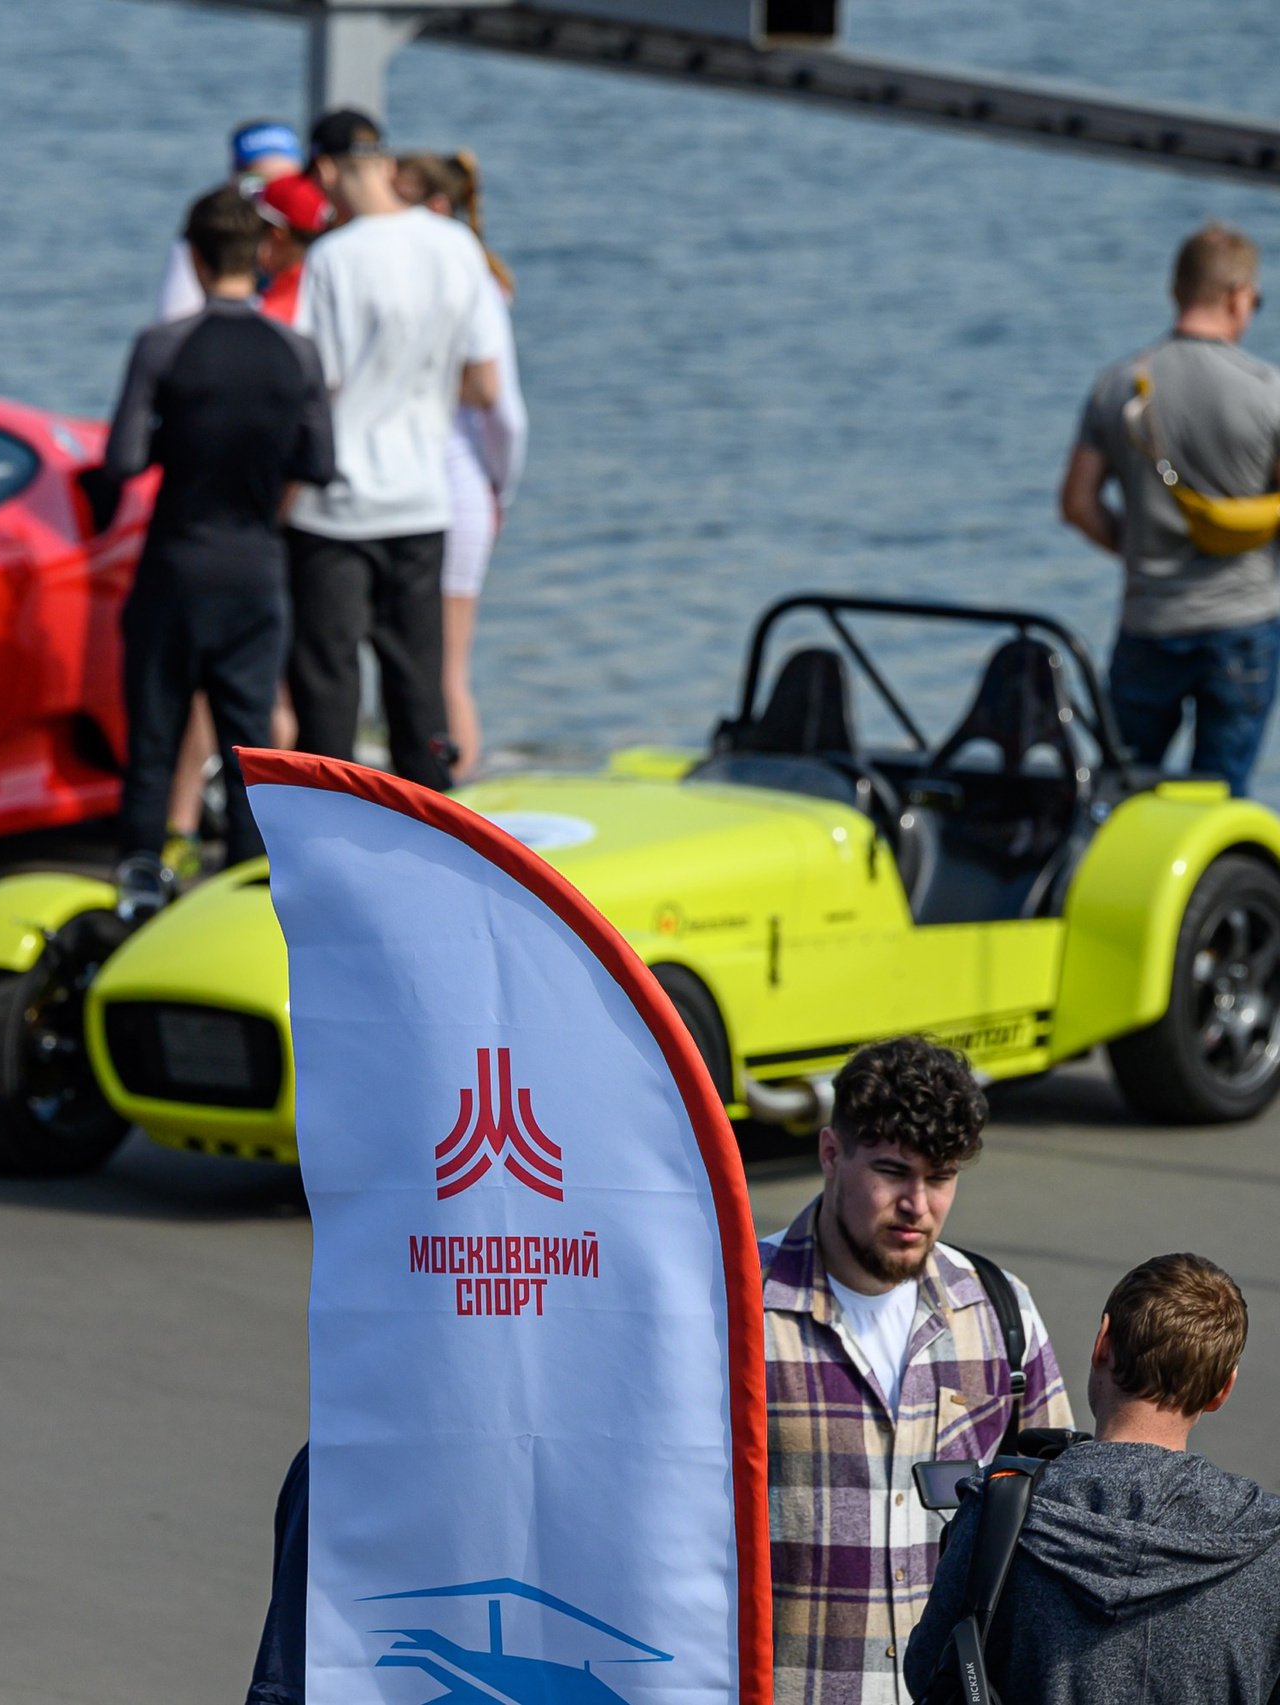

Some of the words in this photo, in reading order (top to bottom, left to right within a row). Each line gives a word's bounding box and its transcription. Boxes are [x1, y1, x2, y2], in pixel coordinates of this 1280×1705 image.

[409, 1230, 599, 1278] МОСКОВСКИЙ
[455, 1278, 548, 1316] СПОРТ
[966, 1661, 981, 1703] RICKZAK
